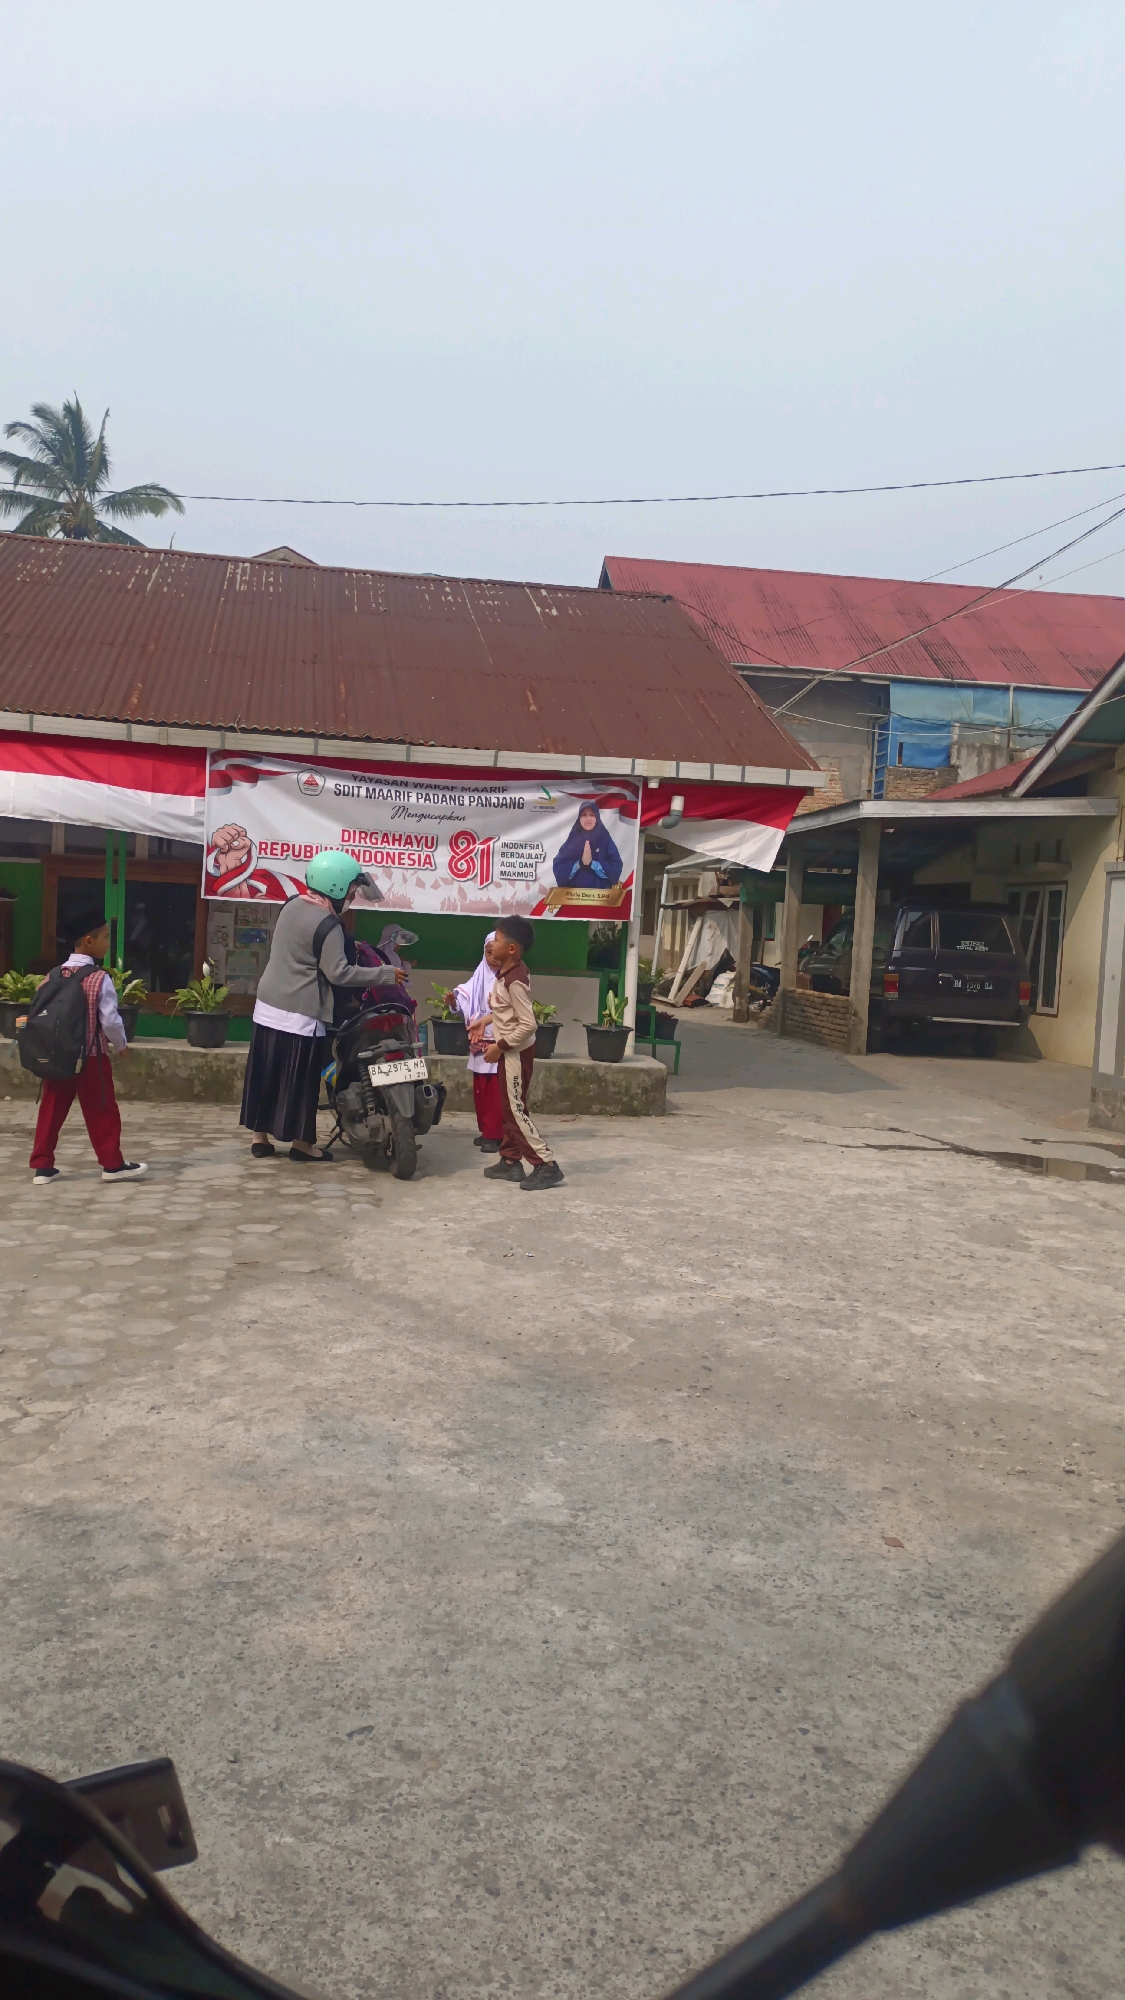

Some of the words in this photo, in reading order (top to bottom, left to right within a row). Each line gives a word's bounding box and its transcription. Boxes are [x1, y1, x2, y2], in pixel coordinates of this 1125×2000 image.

[352, 774, 409, 787] YAYASAN
[413, 781, 458, 791] WAKAF
[461, 786, 509, 794] MAARIF
[334, 783, 362, 798] SDIT
[365, 786, 413, 802] MAARIF
[416, 792, 465, 807] PADANG
[468, 795, 525, 810] PANJANG
[390, 805, 467, 825] Mengucapkan
[341, 828, 435, 850] DIRGAHAYU
[501, 841, 540, 850] INDONESIA
[258, 840, 340, 859] REPUB
[448, 829, 499, 887] 81
[500, 851, 544, 860] BERDAULAT
[500, 870, 534, 879] MAKMUR
[518, 861, 534, 869] DAN
[371, 1065, 383, 1076] BA
[387, 1061, 412, 1073] 2975
